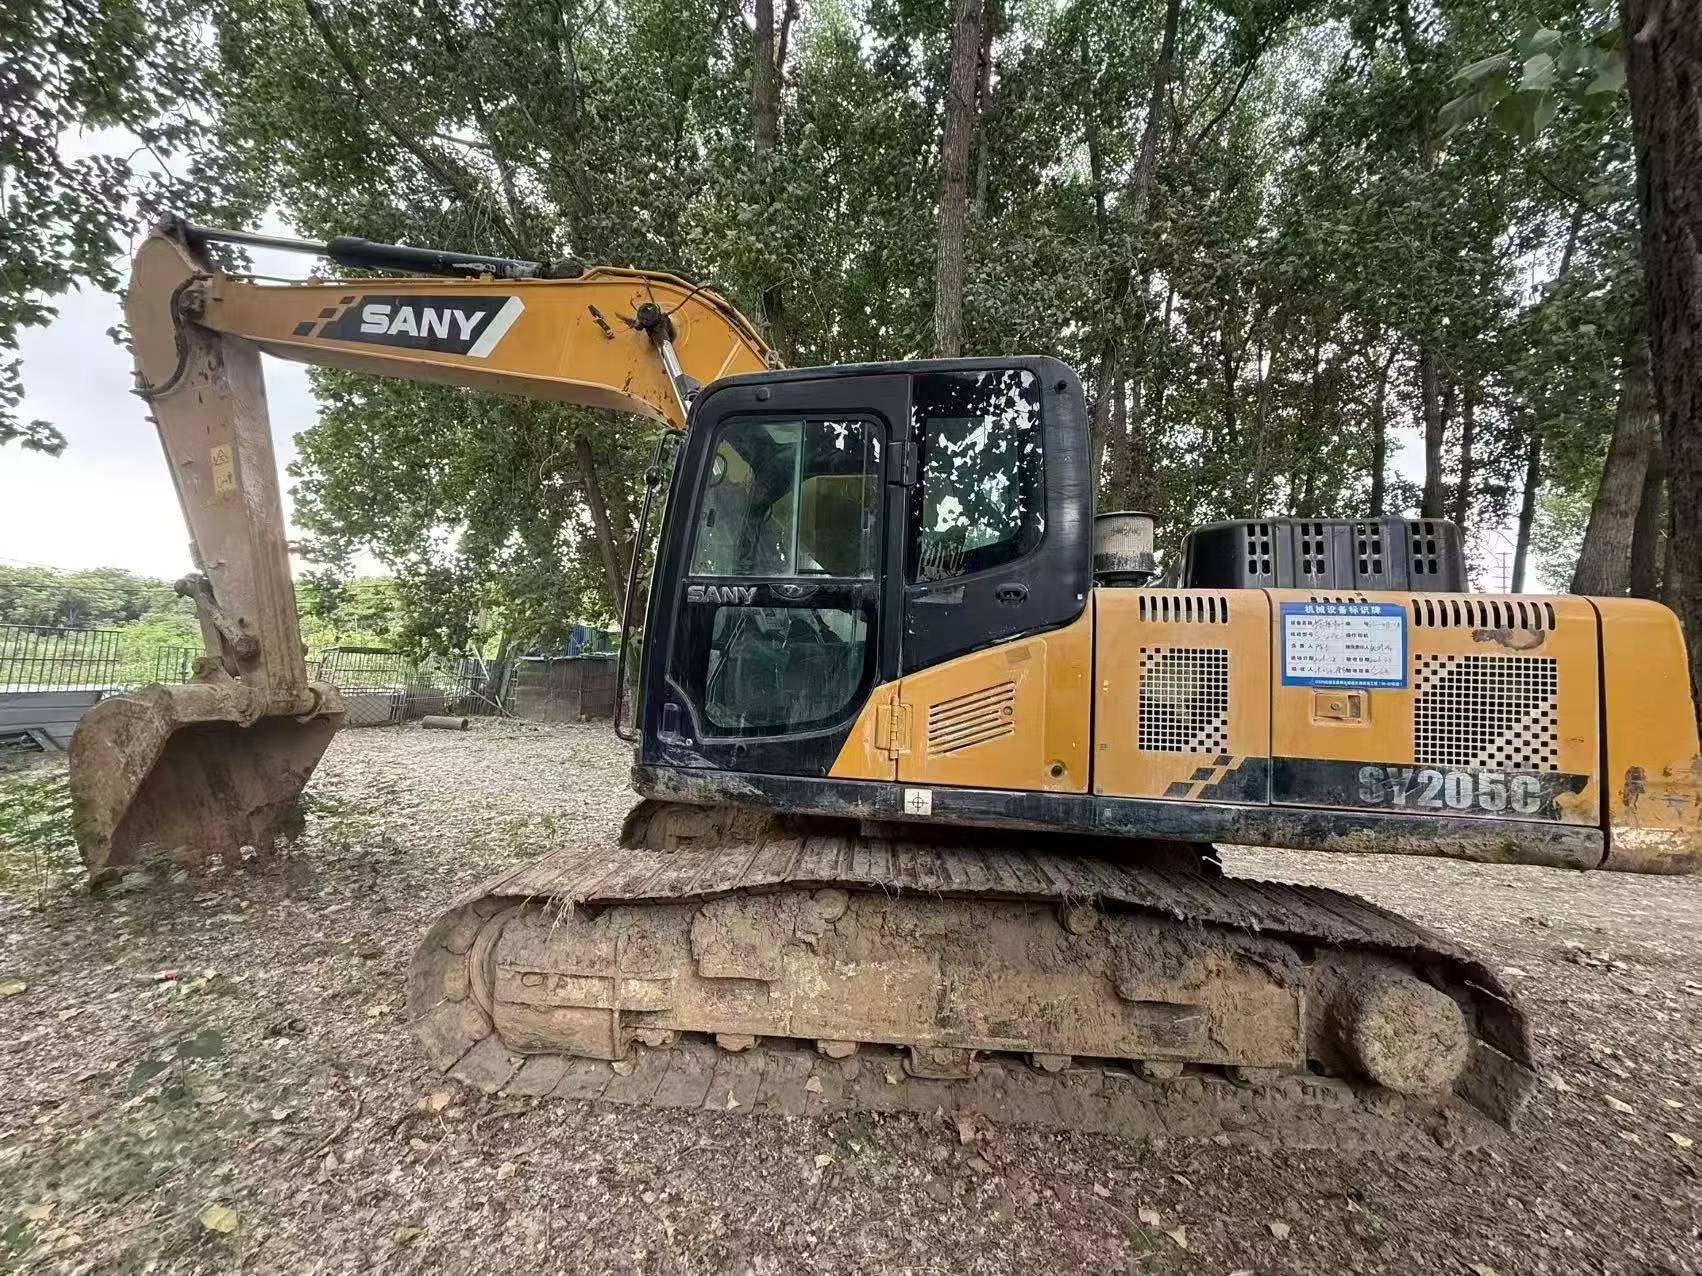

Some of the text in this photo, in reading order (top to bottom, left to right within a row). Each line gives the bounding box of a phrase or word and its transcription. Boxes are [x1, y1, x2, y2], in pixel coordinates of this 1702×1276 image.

[360, 304, 486, 341] SANY
[687, 585, 757, 604] SANY
[1304, 604, 1381, 614] 机械设备标识牌
[1358, 766, 1541, 813] SY205C
